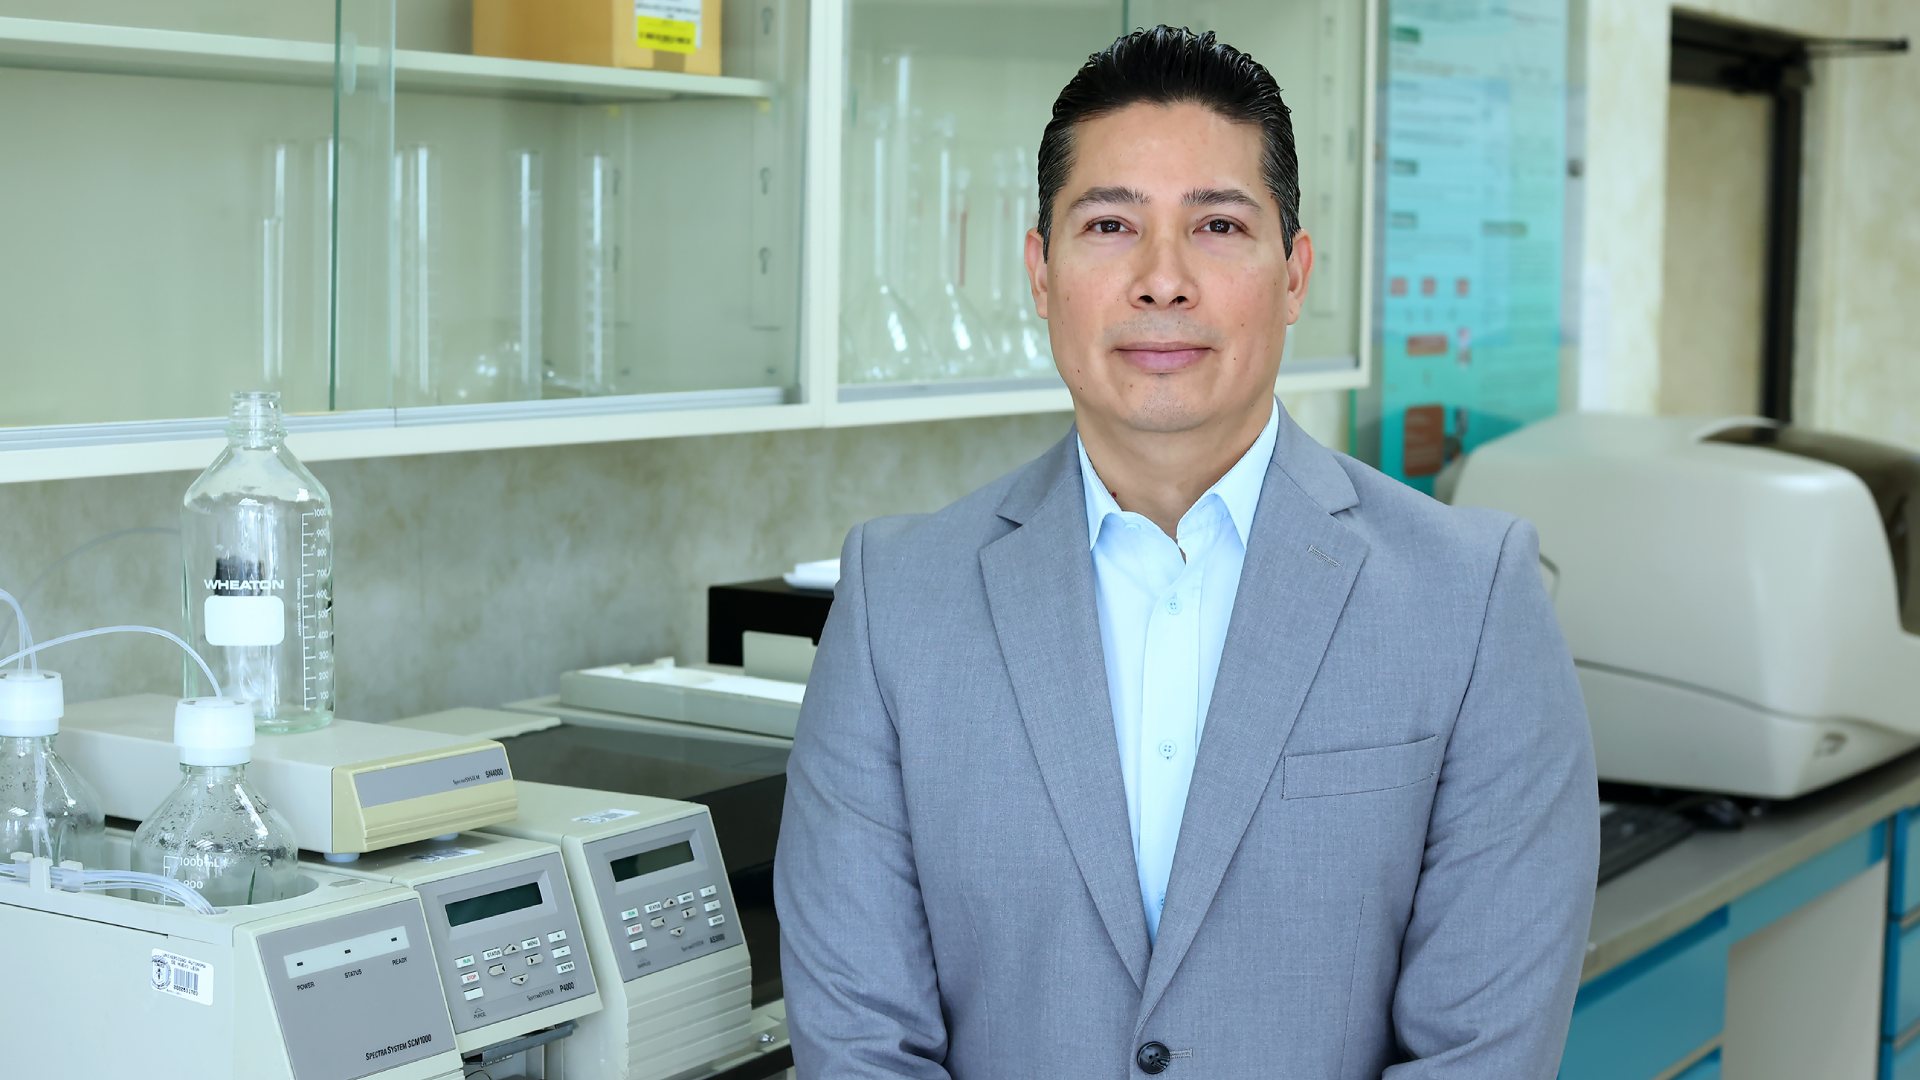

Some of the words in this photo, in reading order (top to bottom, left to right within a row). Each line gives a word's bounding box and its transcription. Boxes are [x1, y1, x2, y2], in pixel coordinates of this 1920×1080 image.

[203, 579, 285, 590] WHEATON
[318, 630, 330, 640] 400
[318, 651, 329, 661] 300
[392, 957, 407, 966] READY
[344, 969, 362, 978] STATUS
[297, 982, 315, 991] POWER
[560, 982, 574, 992] P4000
